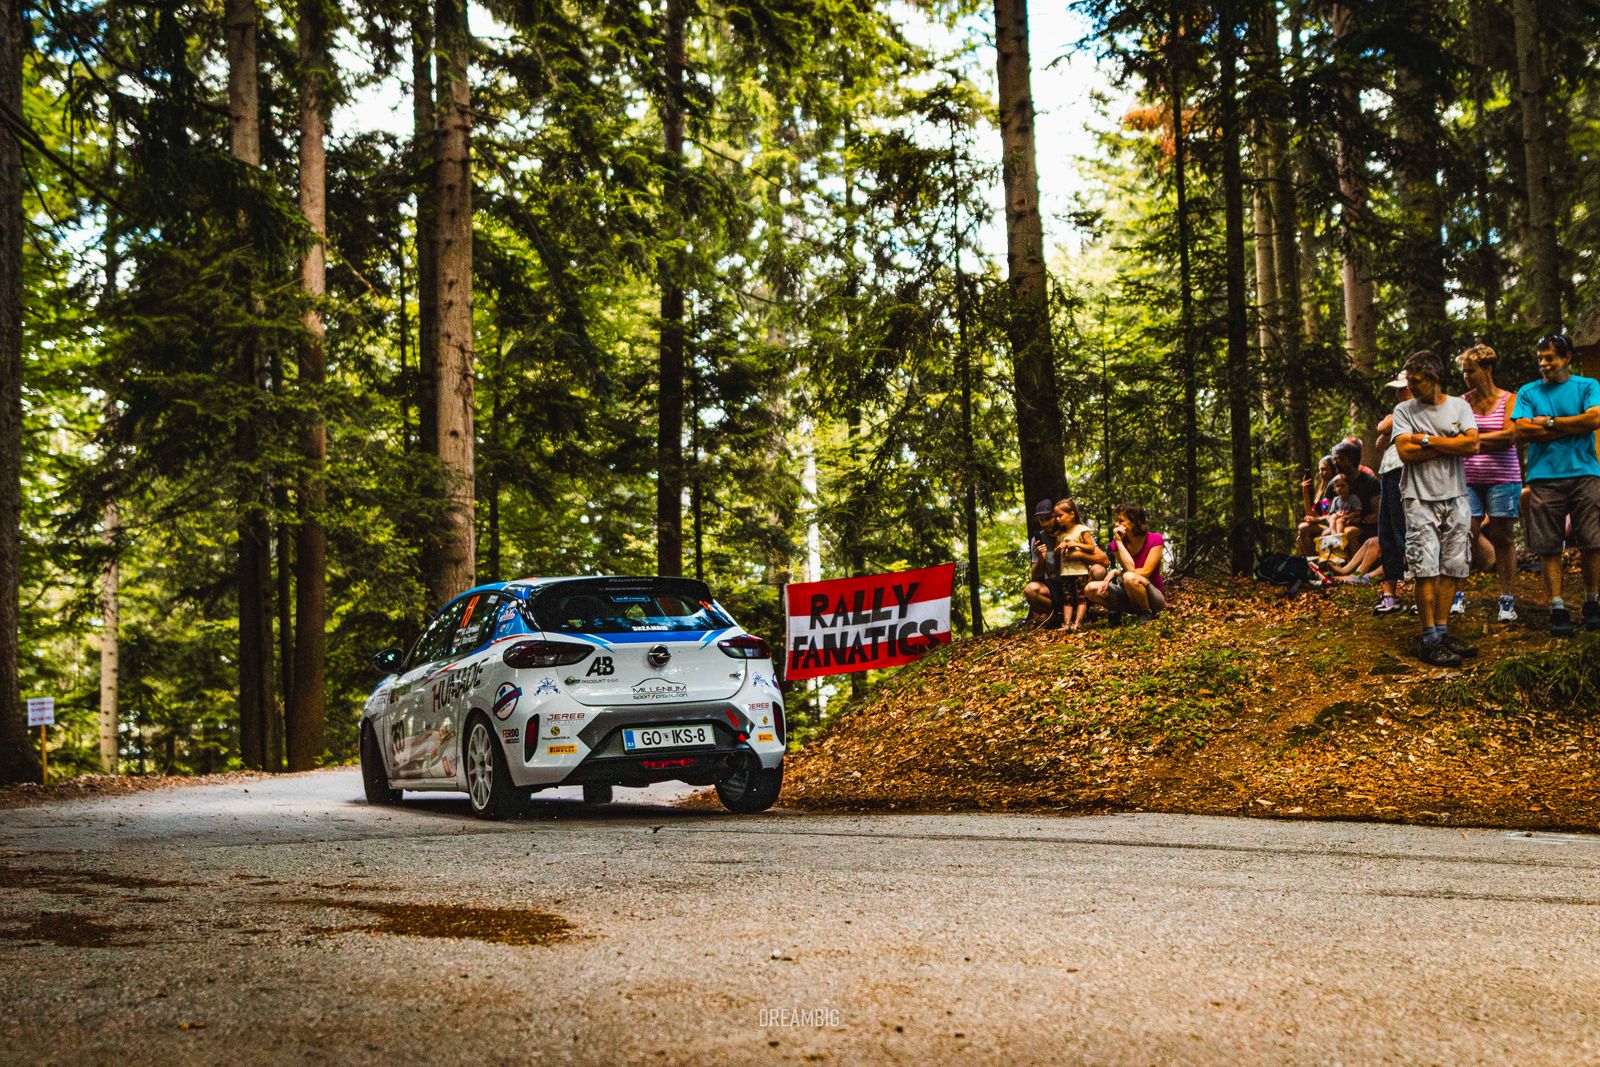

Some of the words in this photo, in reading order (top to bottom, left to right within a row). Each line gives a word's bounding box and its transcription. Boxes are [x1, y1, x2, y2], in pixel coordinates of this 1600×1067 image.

[809, 582, 920, 630] RALLY
[792, 619, 940, 670] FANATICS
[586, 656, 615, 676] AB
[641, 731, 662, 746] GO
[672, 728, 706, 744] IKS-8
